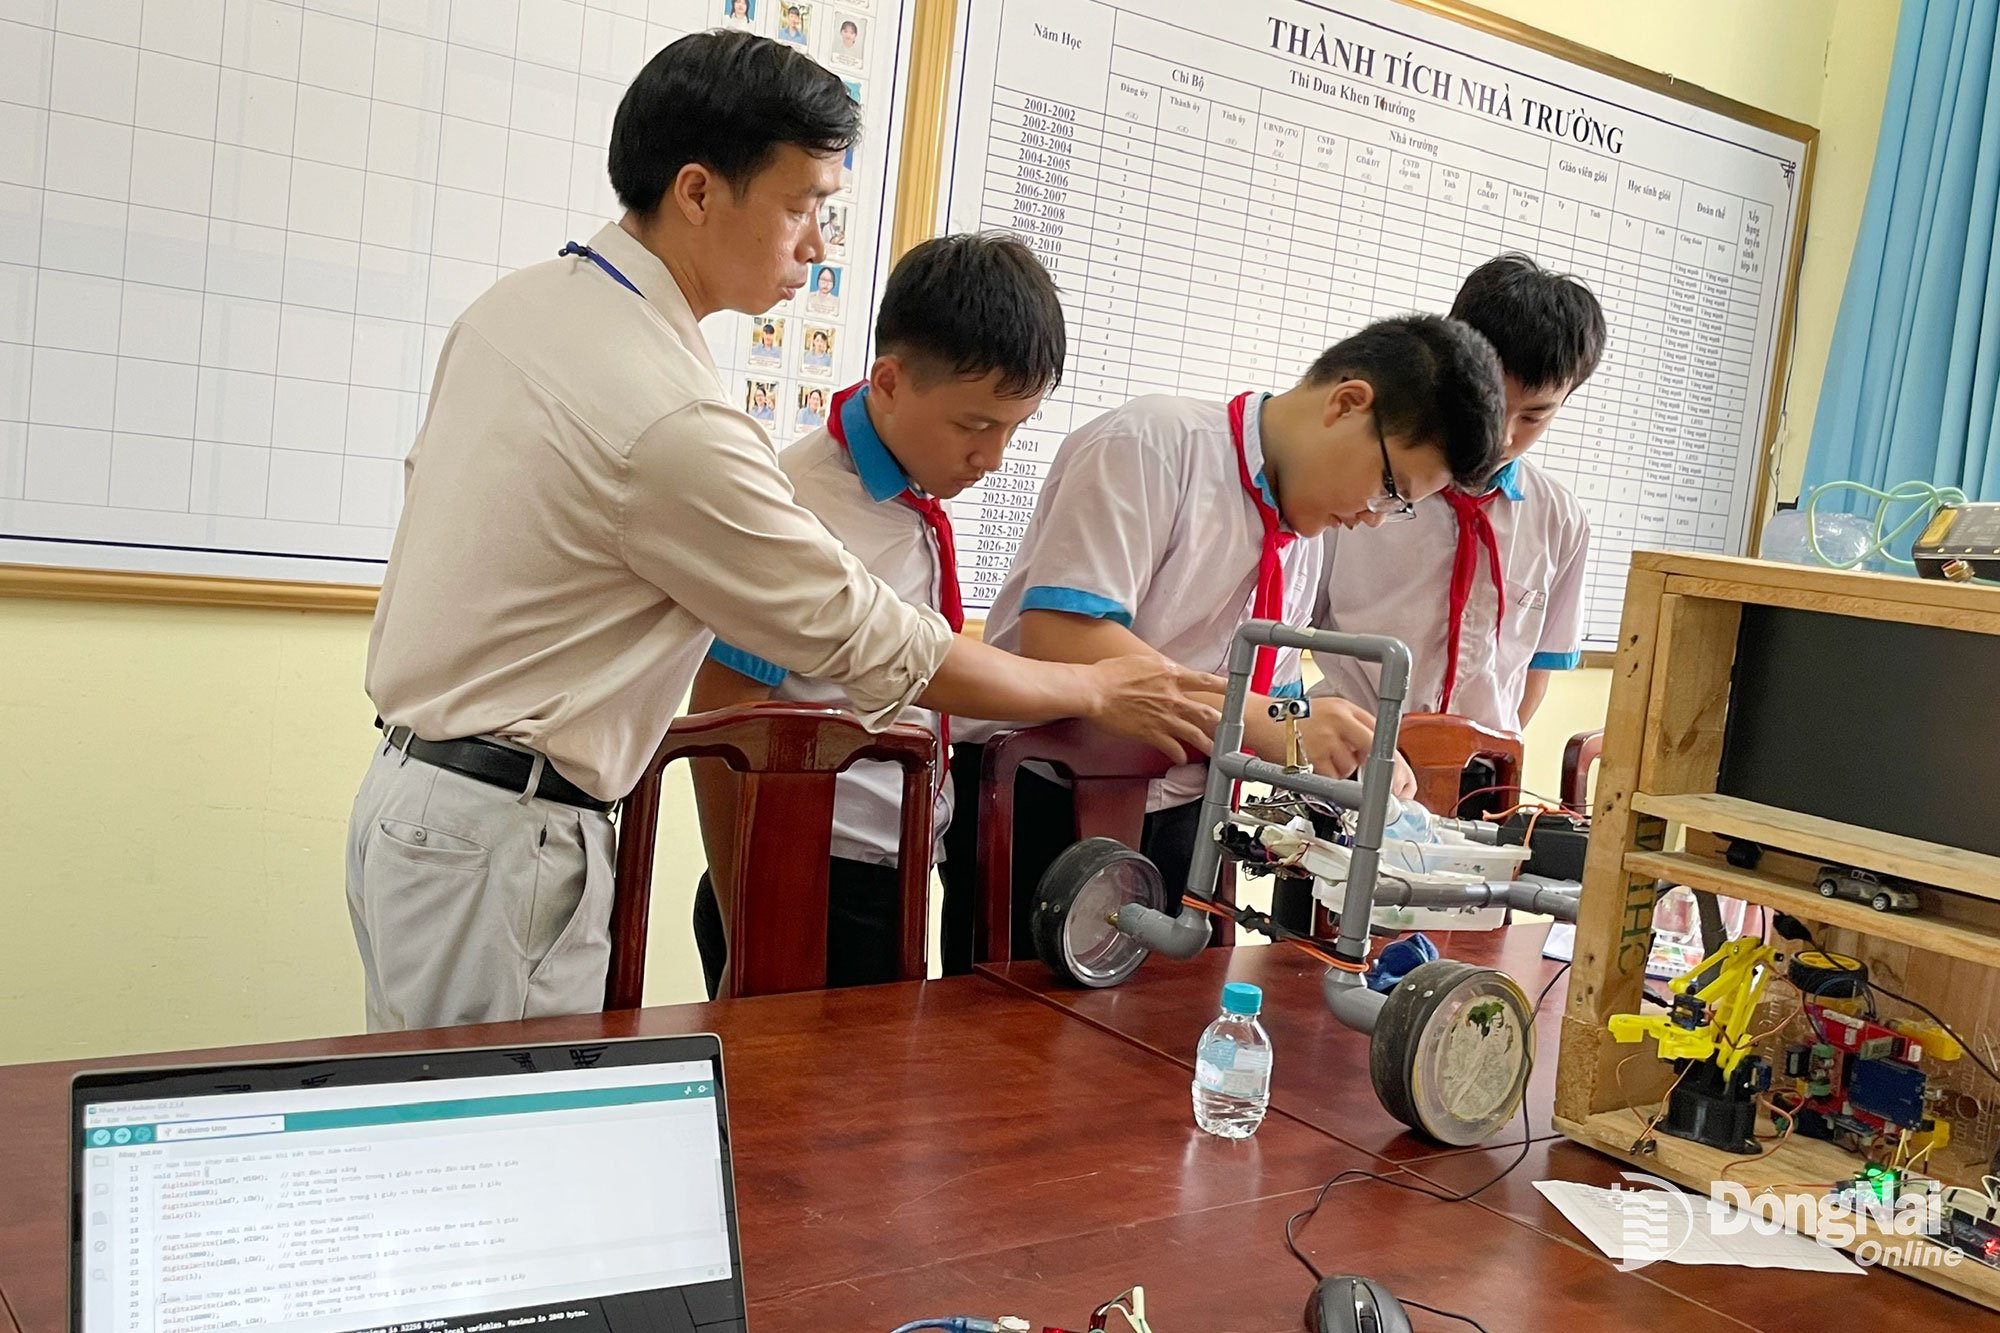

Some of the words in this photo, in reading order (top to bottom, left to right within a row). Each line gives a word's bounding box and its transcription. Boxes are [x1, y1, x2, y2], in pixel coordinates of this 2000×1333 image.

[1033, 23, 1060, 43] Năm
[1062, 33, 1083, 51] Học
[1171, 69, 1188, 85] Chi
[1191, 73, 1205, 93] Bộ
[1267, 17, 1376, 79] THÀNH
[1383, 51, 1453, 102] TÍCH
[1457, 77, 1513, 122] NHÀ
[1521, 97, 1625, 154] TRƯỜNG
[1290, 70, 1309, 89] Thi
[1313, 77, 1336, 97] Đua
[1340, 85, 1370, 106] Khen
[1024, 98, 1077, 121] 2001-2002
[1022, 114, 1074, 138] 2002-2003
[1020, 131, 1073, 155] 2003-2004
[1018, 148, 1071, 171] 2004-2005
[1016, 165, 1069, 188] 2005-2006
[1015, 182, 1067, 204] 2006-2007
[1013, 199, 1065, 221] 2007-2008
[1011, 215, 1063, 237] 2008-2009
[984, 476, 1035, 491] 2022-2023
[982, 492, 1033, 507] 2023-2024
[980, 508, 1031, 522] 2024-2025
[979, 523, 1024, 538] 2025-202
